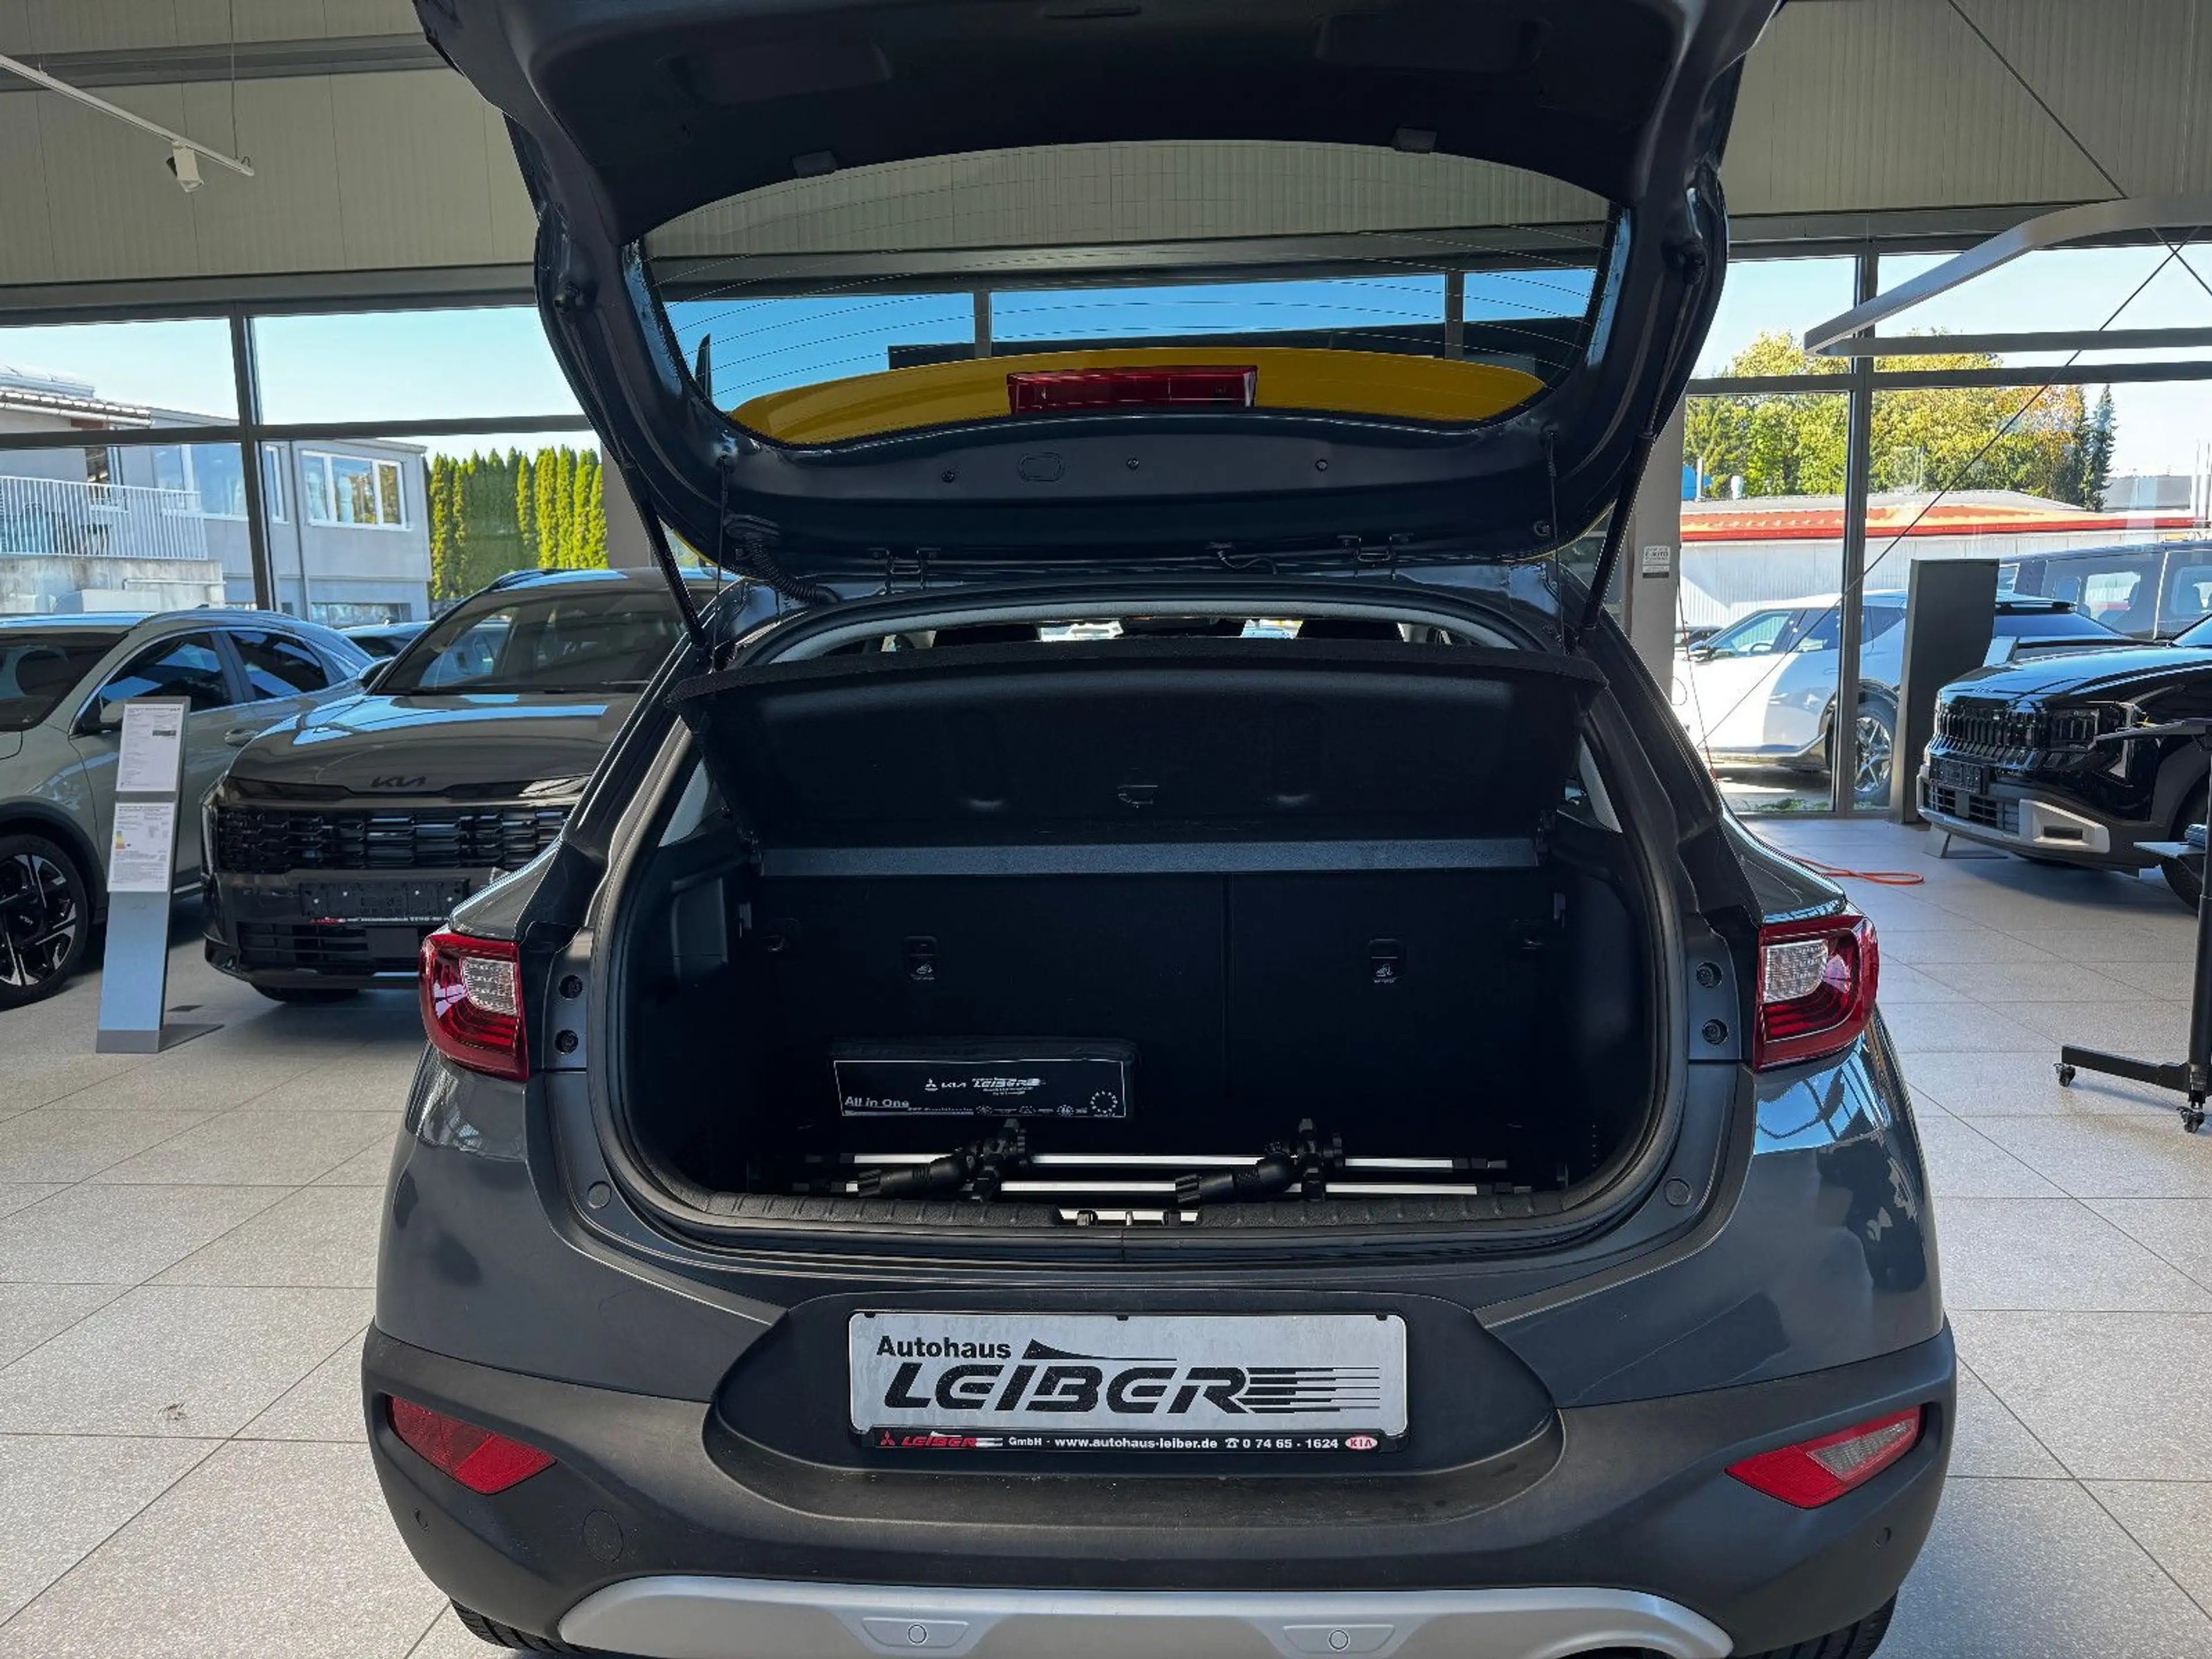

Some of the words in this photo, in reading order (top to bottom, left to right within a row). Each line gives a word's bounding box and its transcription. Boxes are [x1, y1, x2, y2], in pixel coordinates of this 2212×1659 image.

[844, 1096, 862, 1107] All
[865, 1097, 878, 1107] in
[881, 1098, 910, 1107] One
[876, 1335, 1012, 1359] Autohaus
[884, 1362, 1255, 1414] LEIBER
[1009, 1437, 1043, 1446] GmbH
[1054, 1437, 1218, 1449] www.autohaus-leiber.de
[1243, 1438, 1251, 1449] 0
[1256, 1438, 1271, 1449] 74
[1276, 1438, 1292, 1449] 65
[1305, 1438, 1339, 1449] 1624
[1350, 1438, 1372, 1448] KIA
